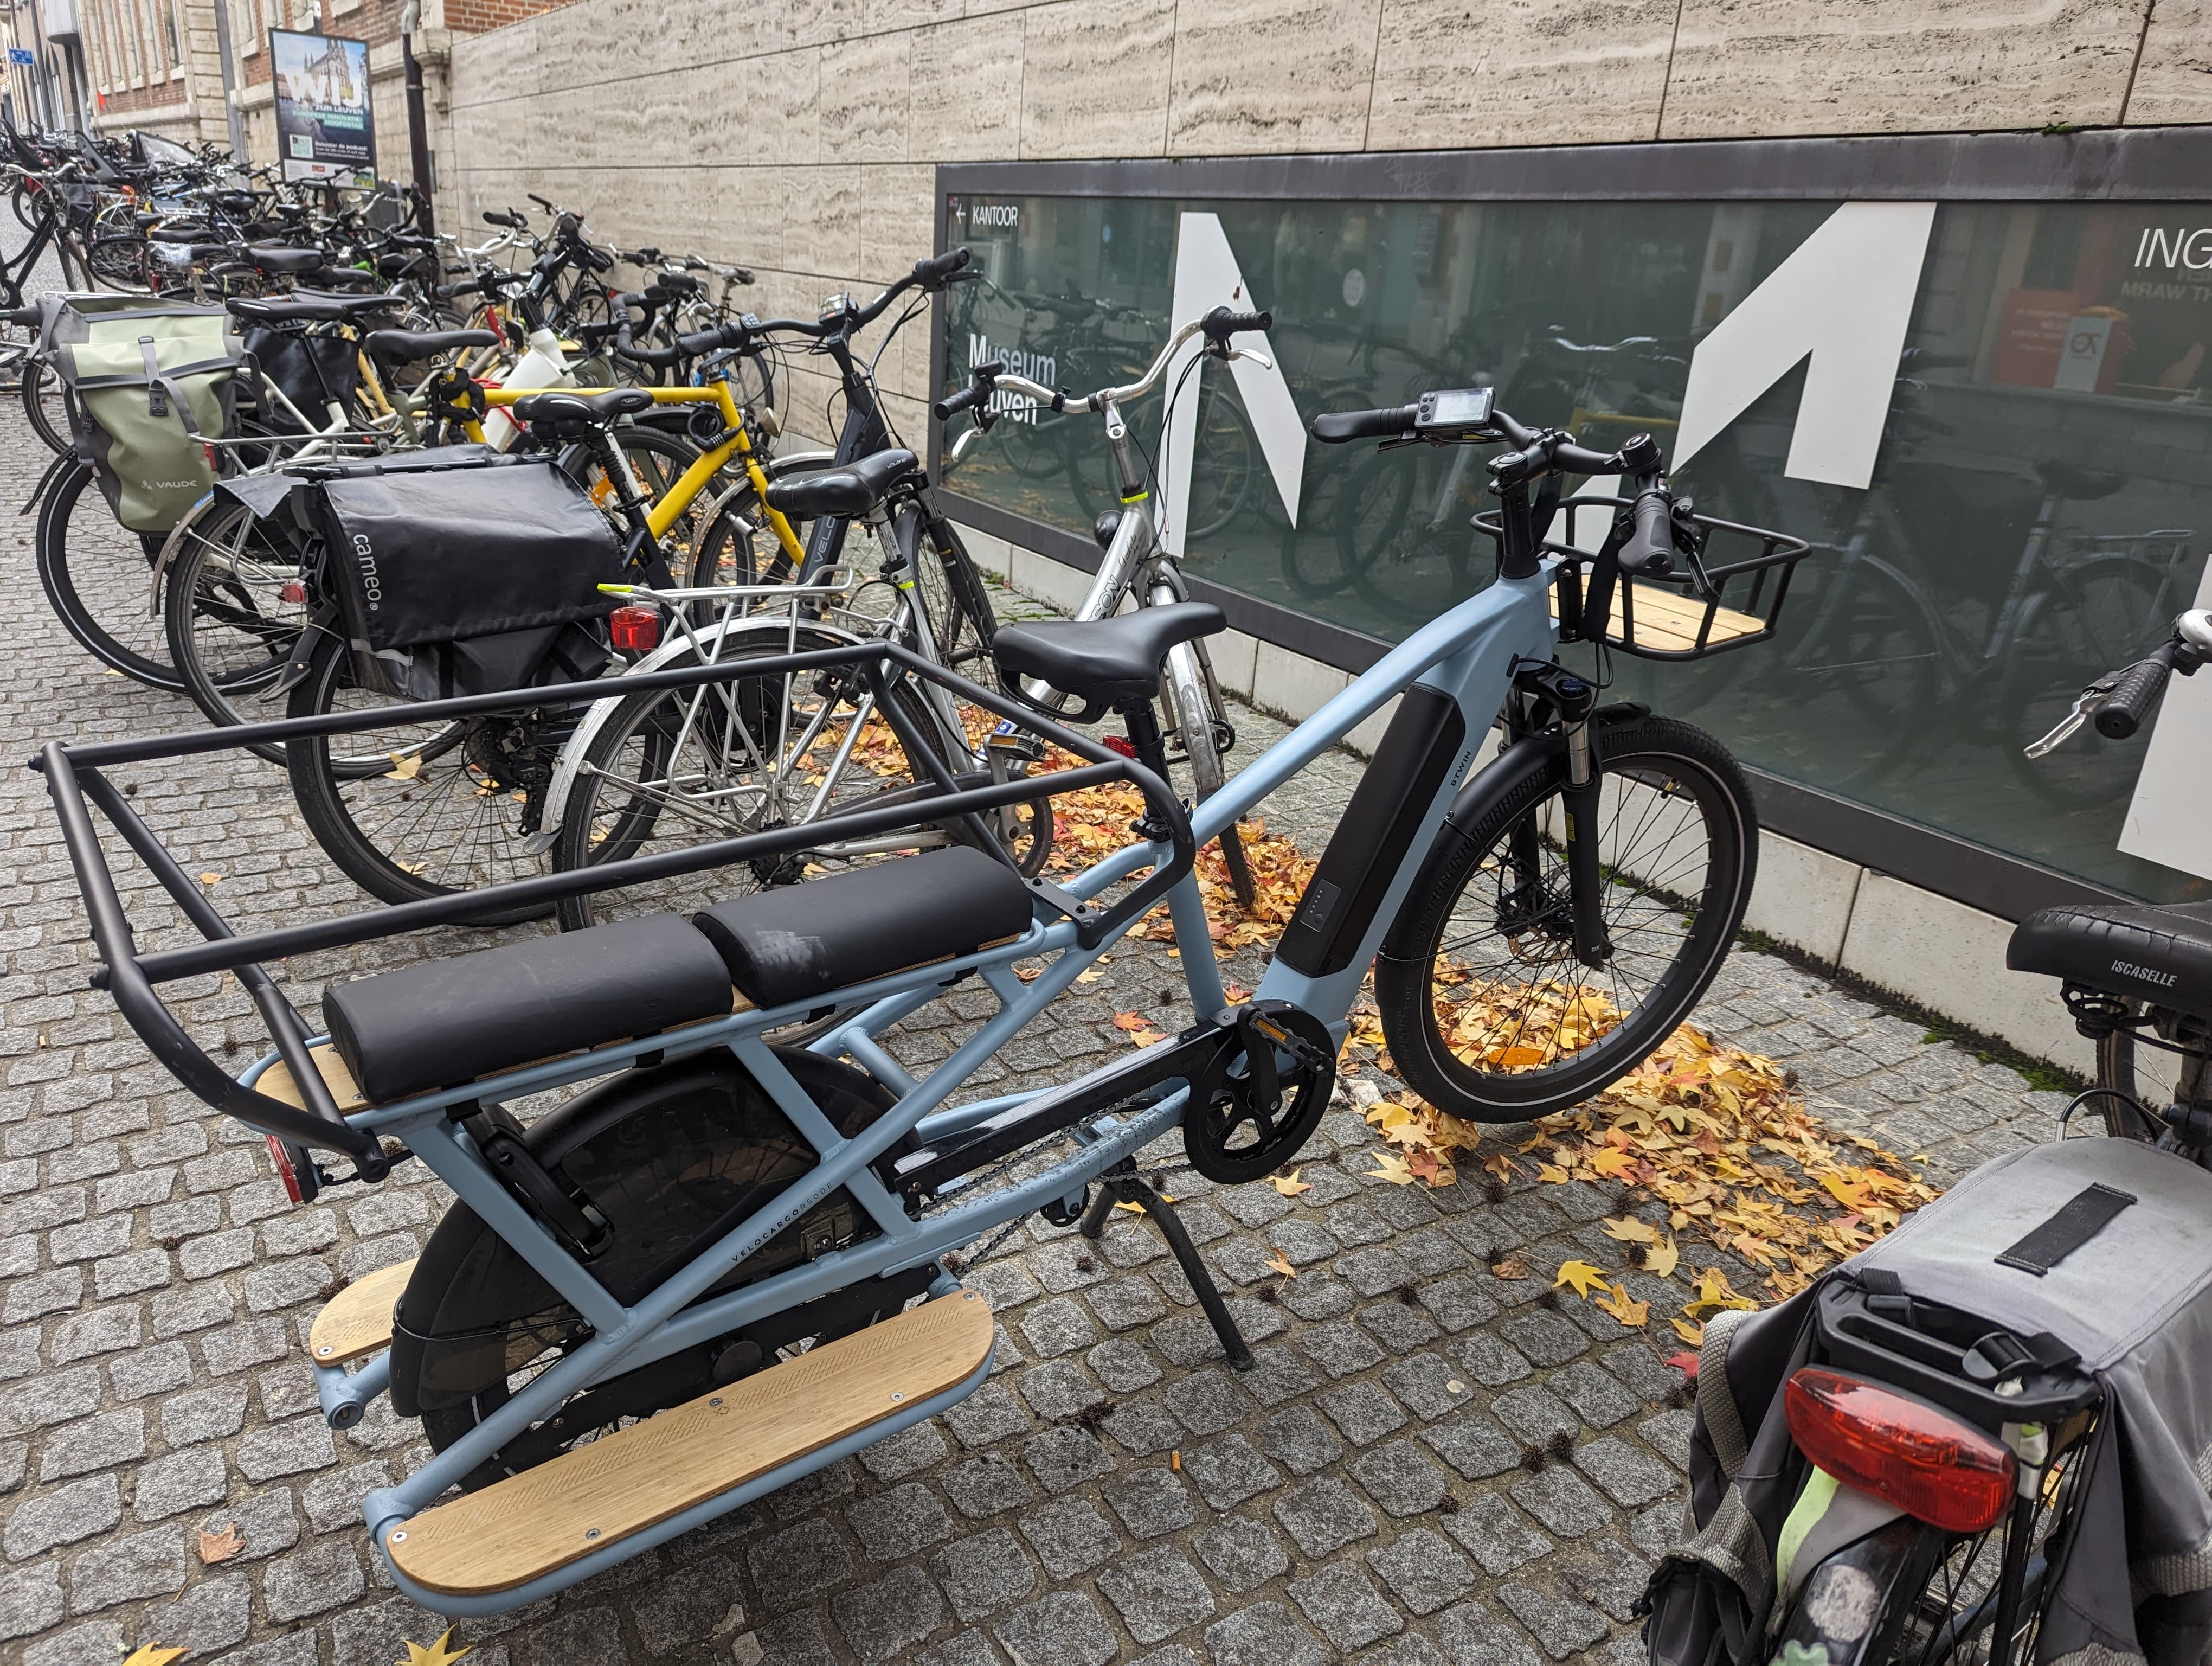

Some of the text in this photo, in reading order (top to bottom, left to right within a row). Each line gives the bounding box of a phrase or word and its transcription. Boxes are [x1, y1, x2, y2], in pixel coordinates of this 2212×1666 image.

[285, 73, 362, 108] WIJ
[333, 106, 363, 114] LEUVEN
[972, 205, 1018, 226] KANTOOR
[968, 374, 1037, 425] uven
[156, 480, 197, 488] VAUDE
[2111, 959, 2178, 987] ISCASELLE
